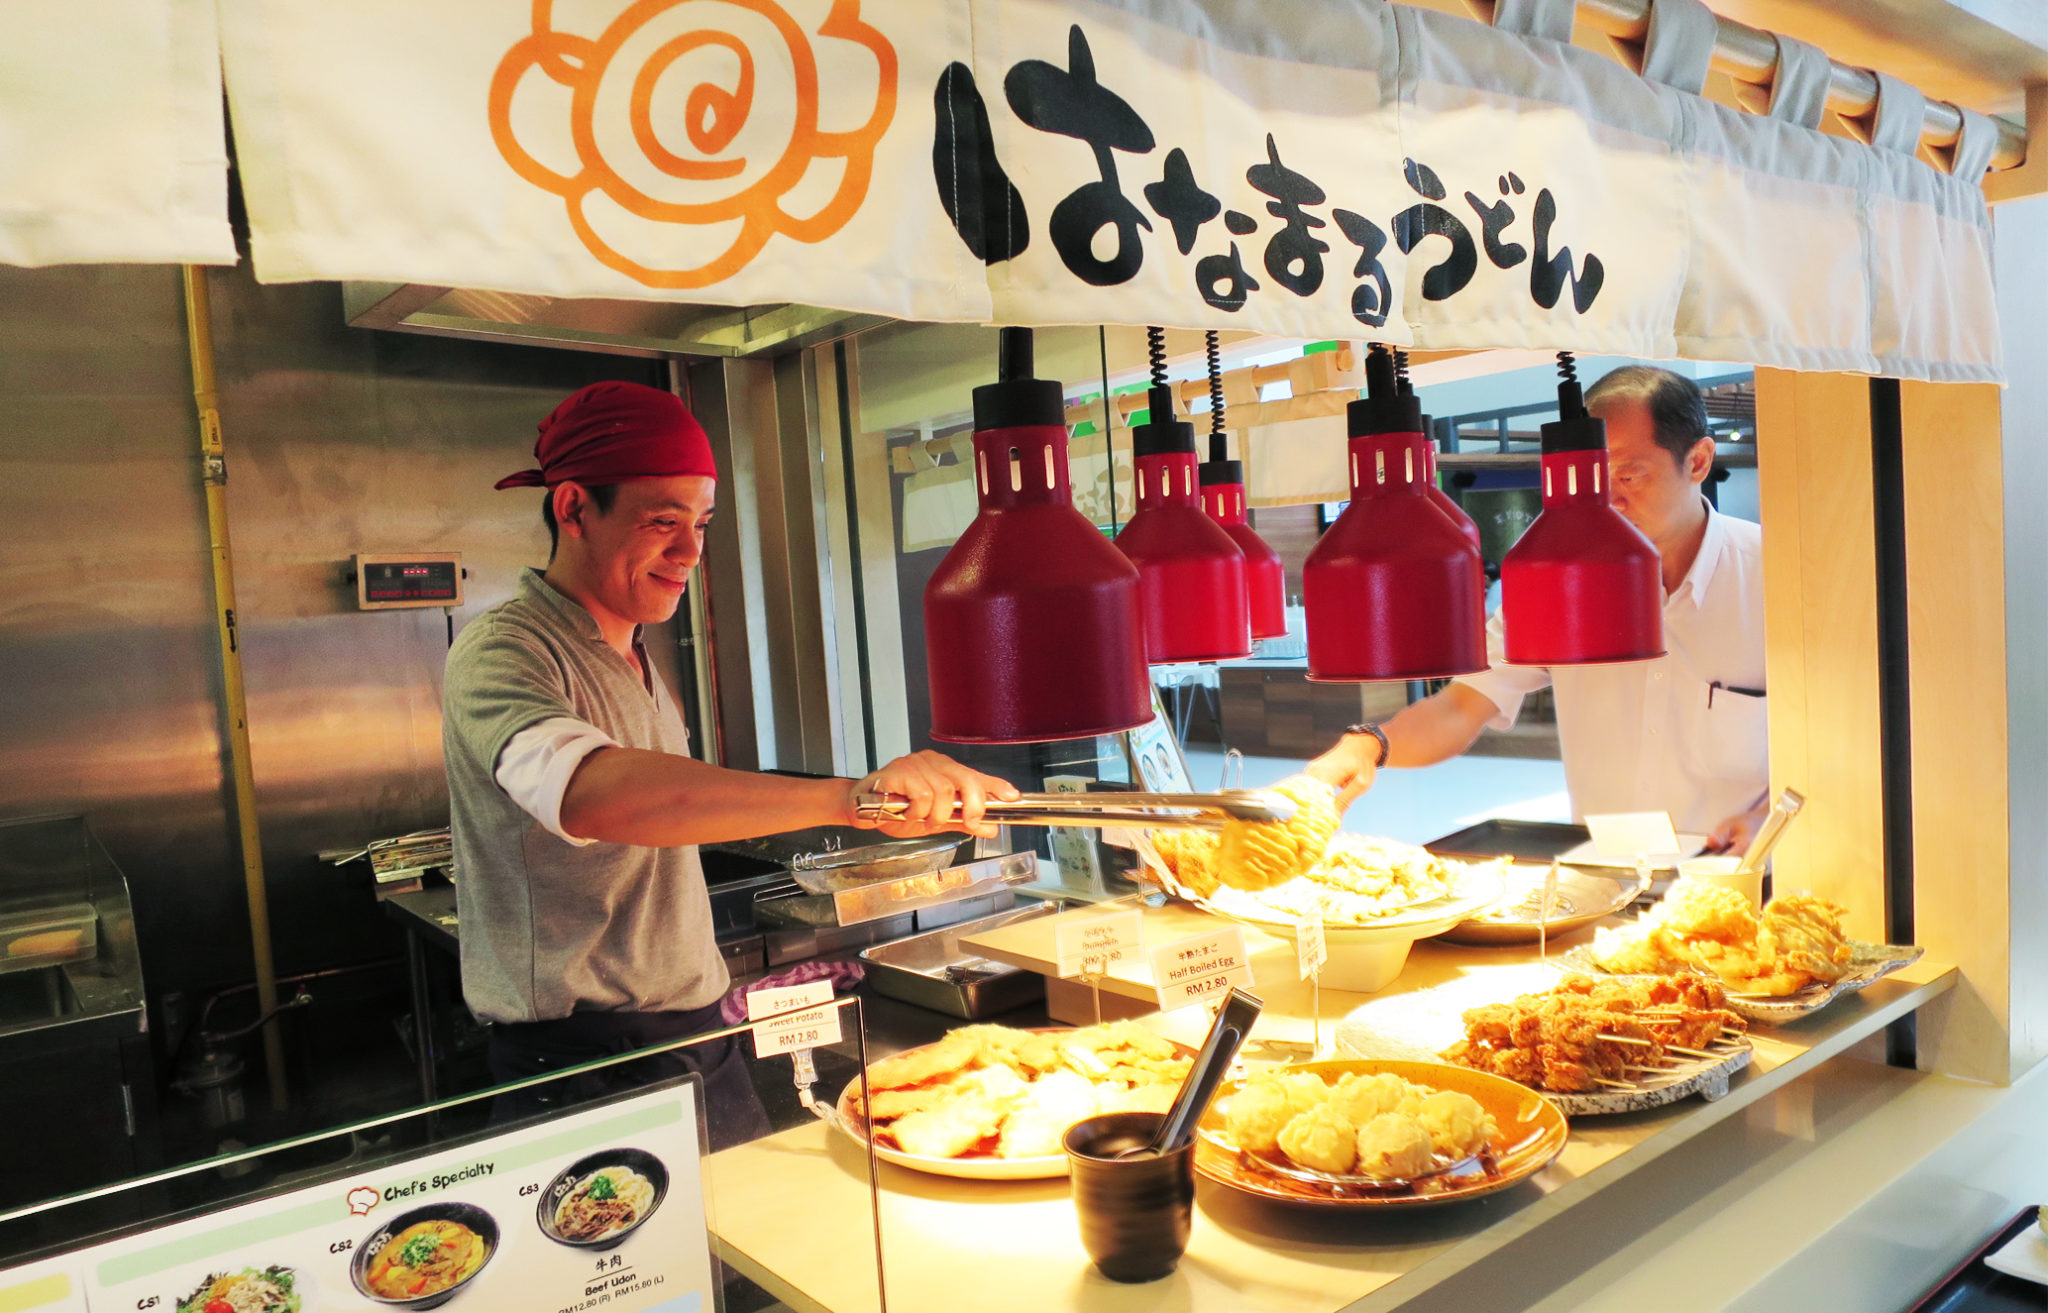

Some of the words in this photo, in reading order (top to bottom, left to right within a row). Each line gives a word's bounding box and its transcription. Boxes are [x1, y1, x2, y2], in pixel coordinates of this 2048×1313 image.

[932, 23, 1605, 328] はなまるうどん
[1169, 967, 1188, 980] Half
[1189, 959, 1218, 975] Boiled
[1218, 957, 1236, 968] Egg
[1186, 983, 1204, 996] RM
[1206, 976, 1228, 990] 2.80
[779, 1034, 795, 1046] RM
[797, 1029, 819, 1043] 2.80
[384, 1181, 427, 1202] Chef's
[431, 1163, 495, 1190] Specialty
[519, 1184, 540, 1197] CS3
[329, 1239, 353, 1254] CS2
[595, 1254, 623, 1272] 牛肉
[585, 1281, 608, 1296] Beef
[611, 1273, 636, 1287] Udon
[598, 1294, 611, 1305] (R)
[614, 1279, 652, 1298] RM15.80
[653, 1275, 665, 1285] (L)
[137, 1295, 160, 1310] CS1
